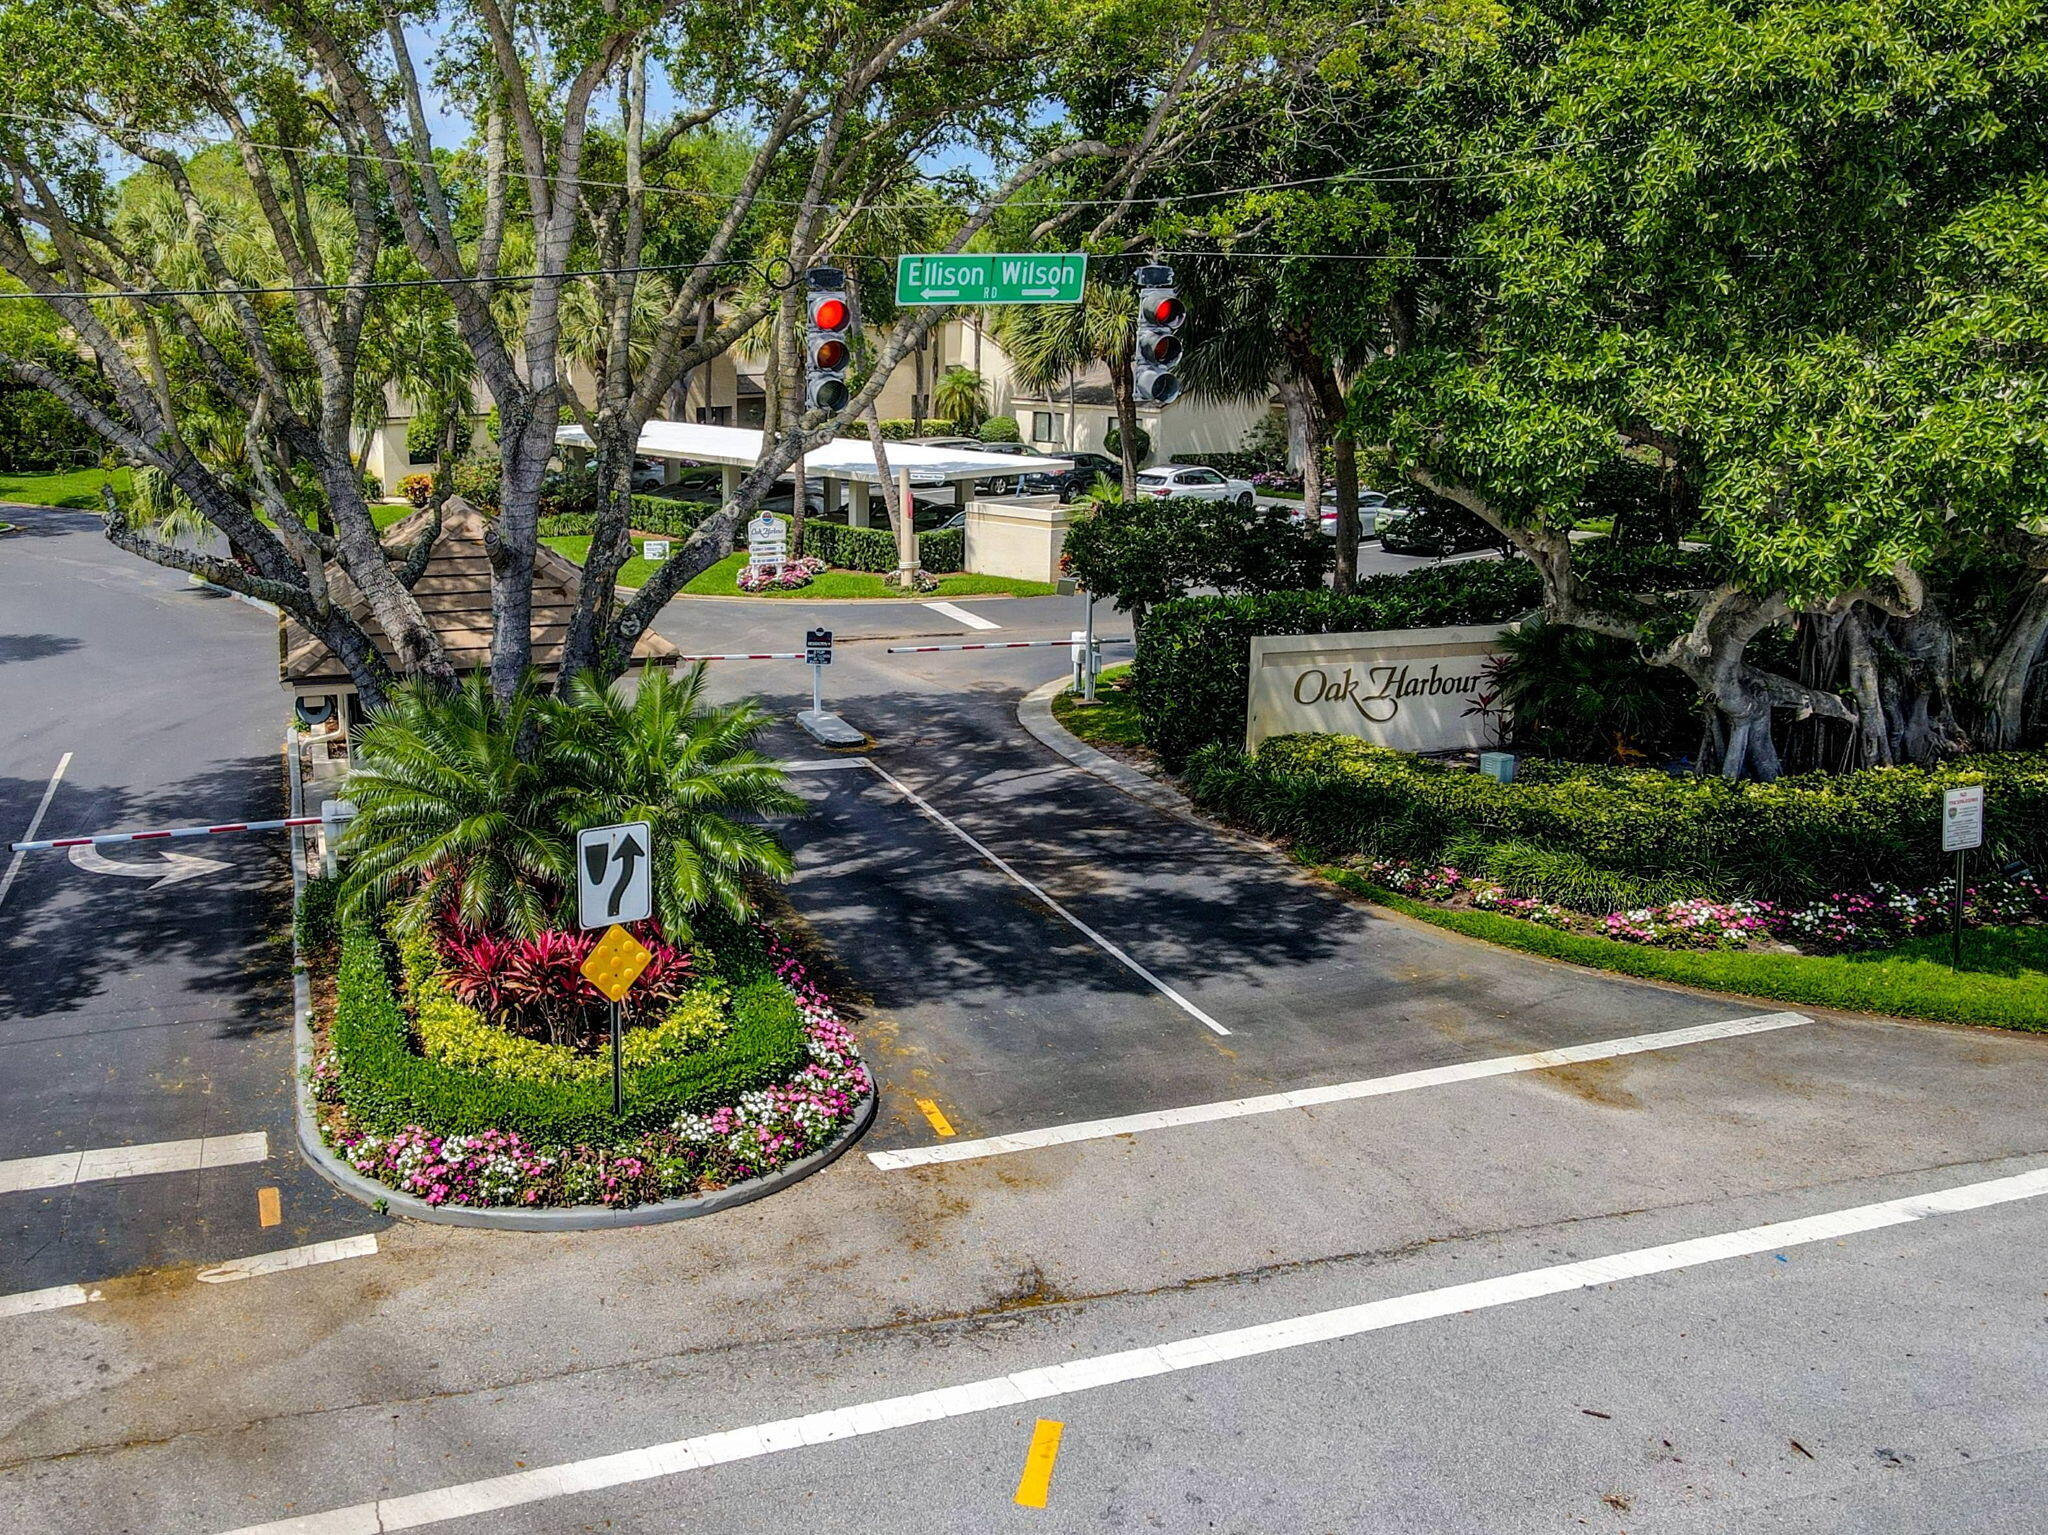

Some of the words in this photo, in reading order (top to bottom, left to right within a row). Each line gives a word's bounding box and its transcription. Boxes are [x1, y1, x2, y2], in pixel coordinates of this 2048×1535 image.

[908, 262, 984, 286] Ellison
[1002, 261, 1074, 285] Wilson
[983, 286, 998, 299] RD
[1294, 668, 1398, 722] Oak
[1362, 664, 1482, 701] Harbour
